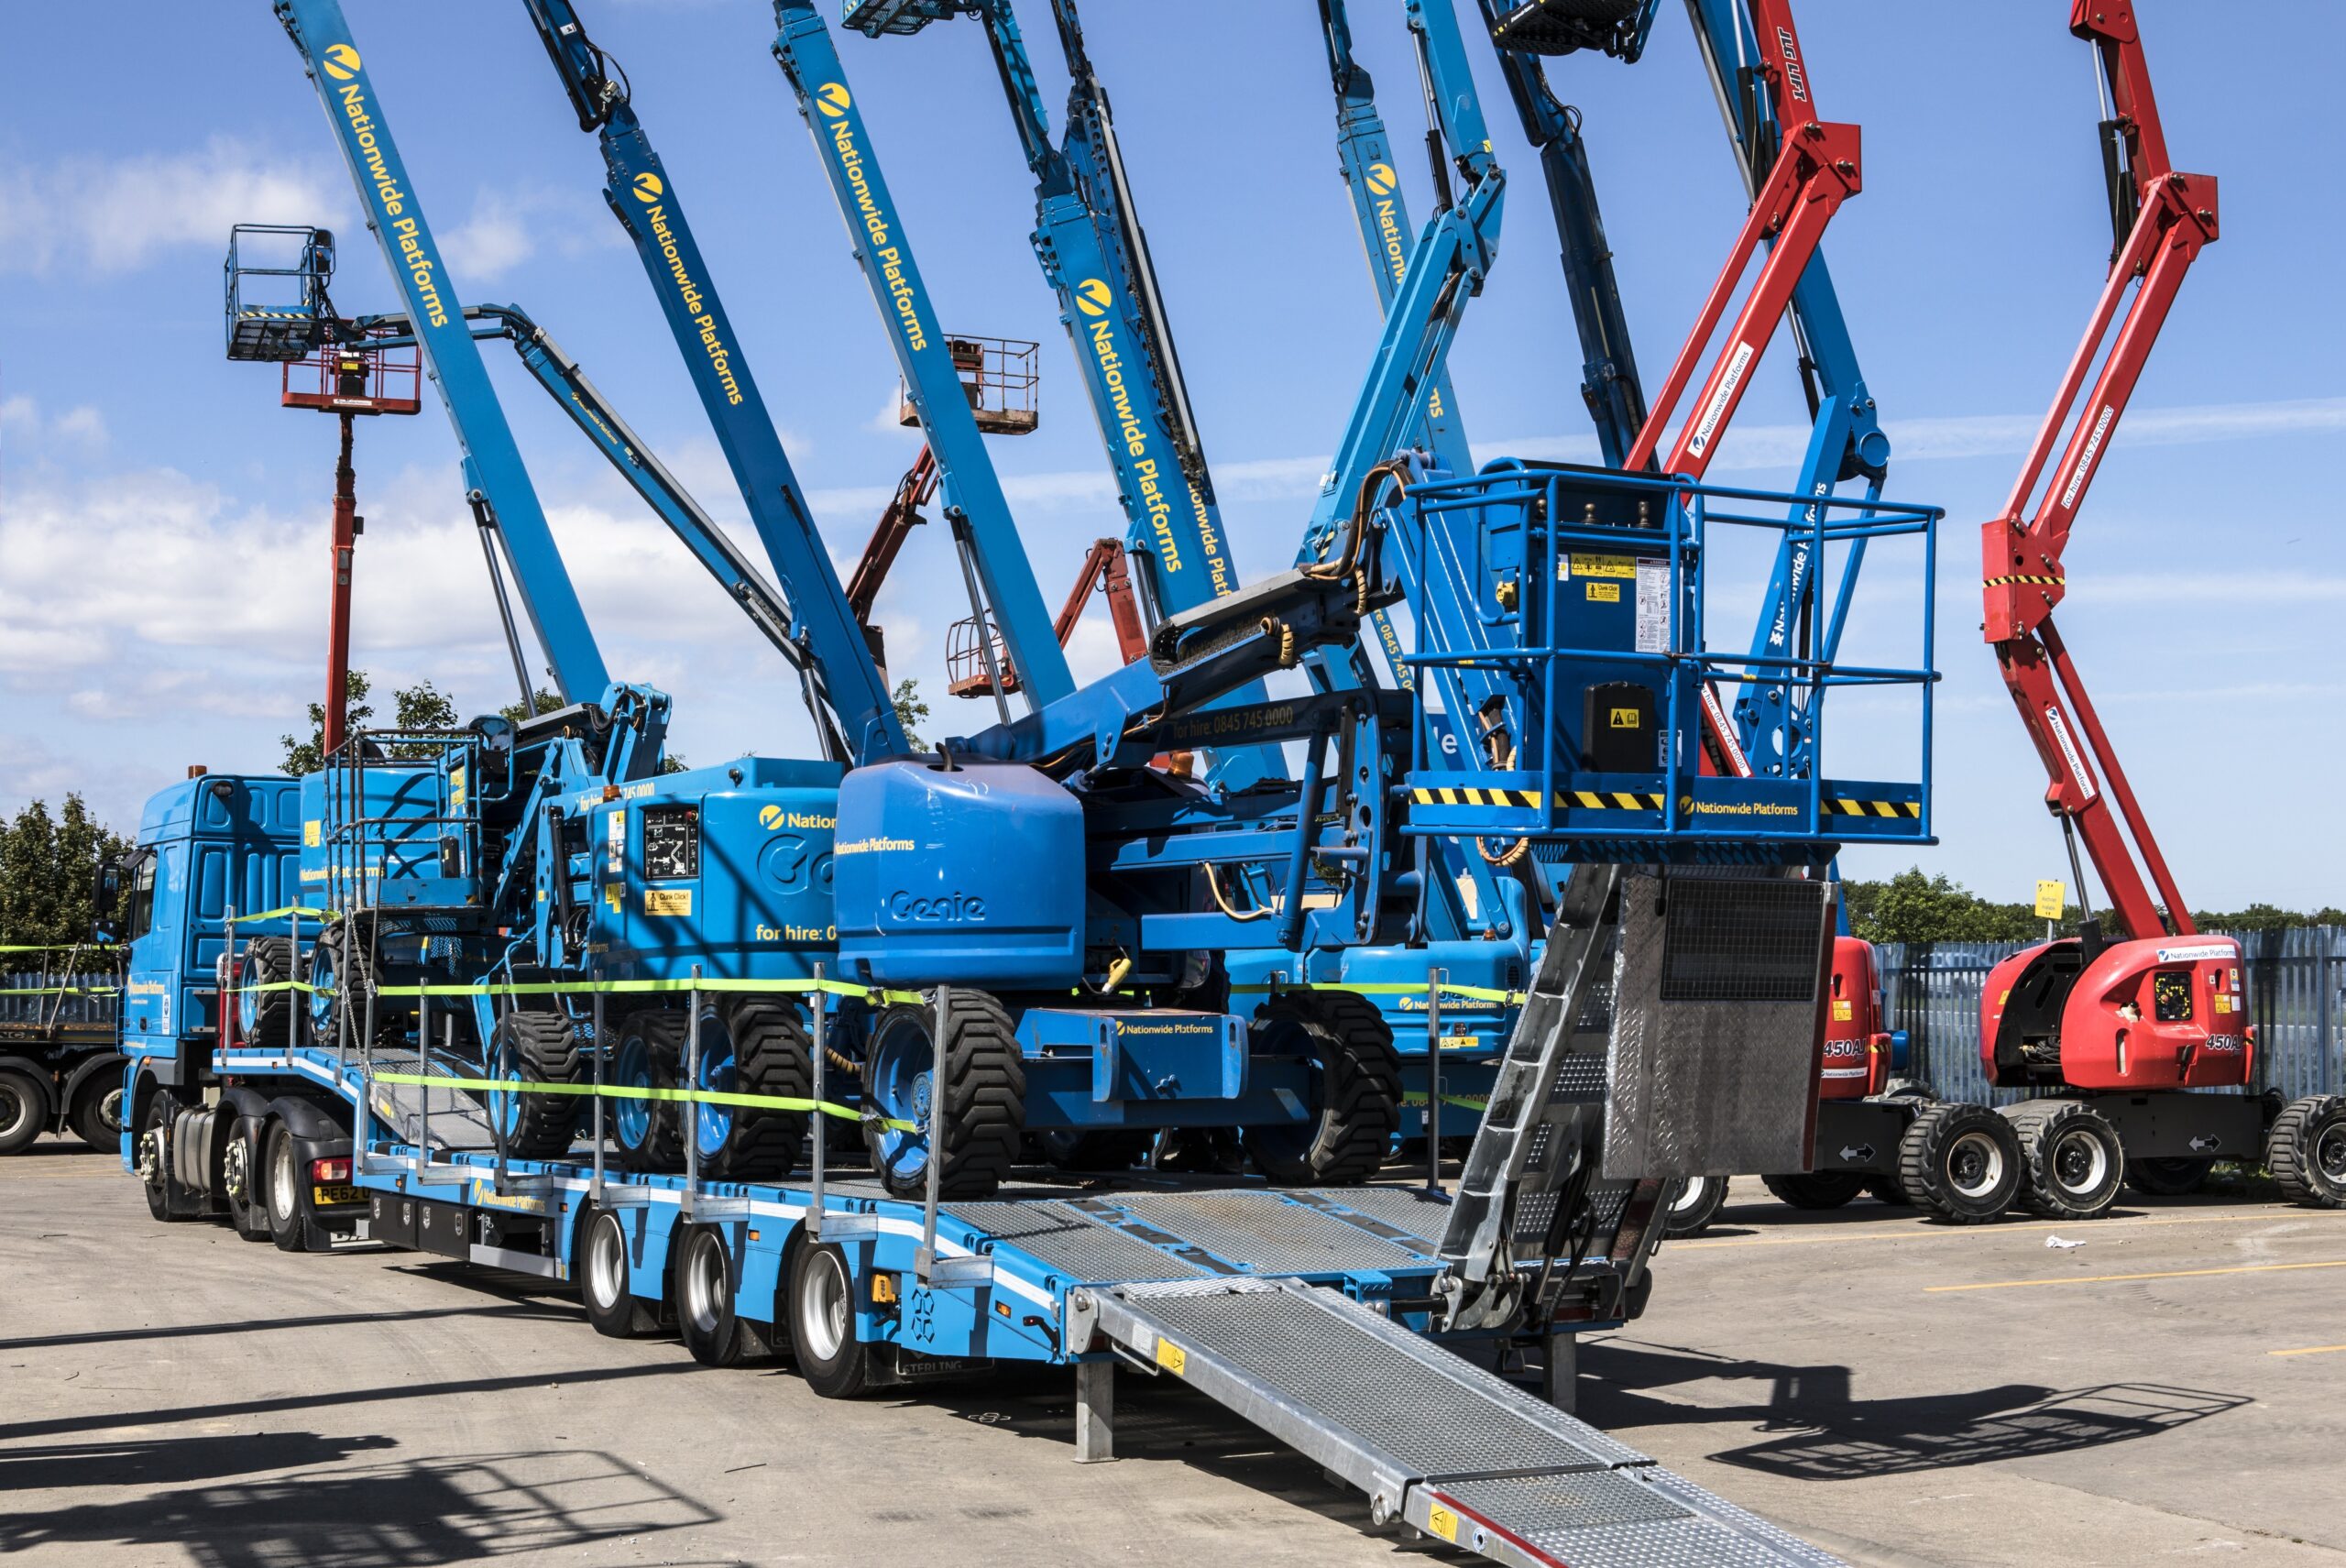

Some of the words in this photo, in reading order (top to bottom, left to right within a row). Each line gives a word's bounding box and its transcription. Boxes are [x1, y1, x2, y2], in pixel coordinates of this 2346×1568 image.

[1777, 27, 1797, 60] JLG
[1786, 61, 1807, 102] LIFT
[339, 84, 403, 215] Nationwide
[393, 217, 448, 328] Platforms
[831, 120, 888, 246] Nationwide
[879, 247, 927, 351] Platforms
[646, 205, 703, 314] Nationwide
[695, 314, 743, 405] Platforms
[1702, 389, 1728, 437] Nationwide
[1725, 351, 1749, 389] Platforms
[1090, 320, 1146, 457] Nationwide
[1135, 458, 1182, 574] Platforms
[2062, 494, 2074, 508] for
[2078, 449, 2094, 473] 0845
[2089, 430, 2102, 449] 745
[2098, 406, 2113, 431] 0000
[1381, 624, 1399, 654] 0845
[1393, 655, 1409, 678] 745
[1213, 715, 1241, 733] 0845
[1244, 710, 1263, 729] 745
[1266, 706, 1293, 727] 0000
[1714, 711, 1728, 732] 0845
[1725, 732, 1735, 750] 745
[1732, 748, 1746, 769] 0000
[2053, 721, 2075, 762] Nationwide
[1696, 801, 1752, 815] Nationwide
[1753, 803, 1799, 816] Platforms
[835, 839, 869, 855] Nationwide
[869, 836, 915, 851] Platforms
[890, 889, 988, 922] Genie
[756, 925, 781, 941] for
[785, 924, 823, 941] hire:
[2170, 948, 2209, 959] Nationwide
[1461, 999, 1497, 1009] Platforms
[1126, 1025, 1173, 1034] Nationwide
[1174, 1024, 1213, 1034] Platforms
[1823, 1038, 1867, 1058] 450AJ
[322, 1187, 358, 1202] PE62
